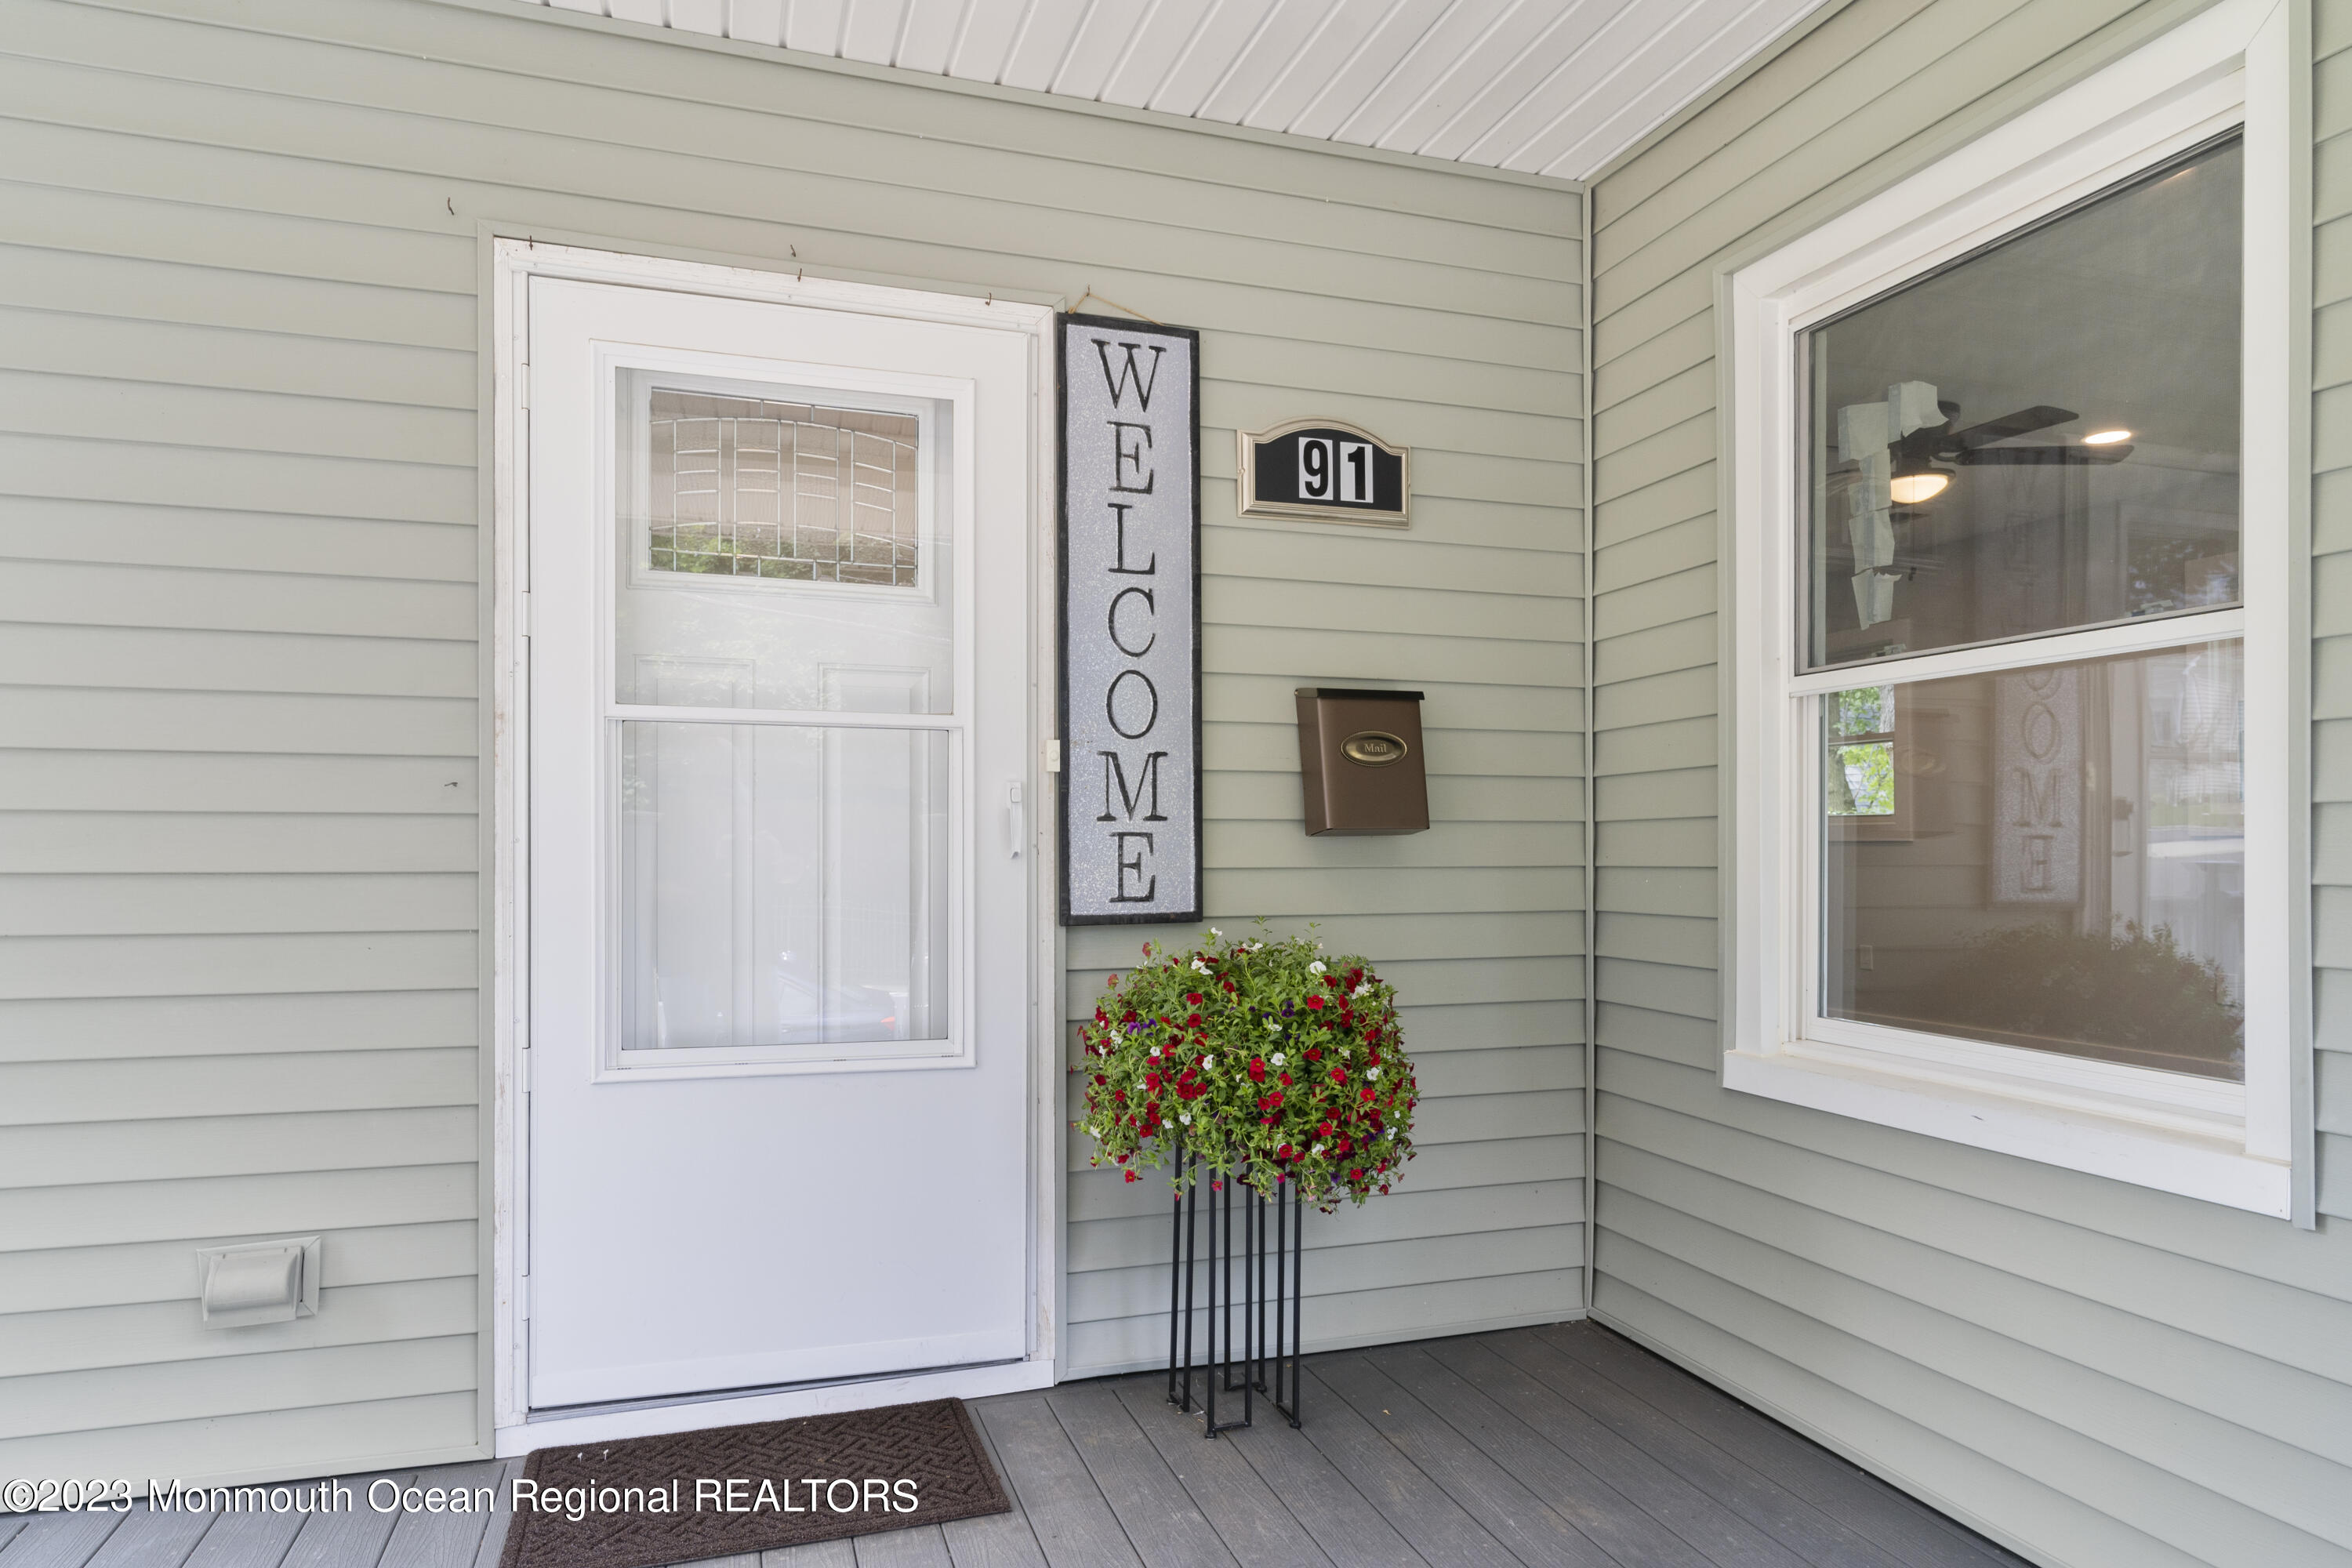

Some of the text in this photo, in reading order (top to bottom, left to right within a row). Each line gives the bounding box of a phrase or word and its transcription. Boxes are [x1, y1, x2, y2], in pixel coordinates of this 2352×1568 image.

[1302, 439, 1367, 501] 91
[1091, 338, 1168, 904] WELCOME
[1364, 743, 1387, 753] Mail
